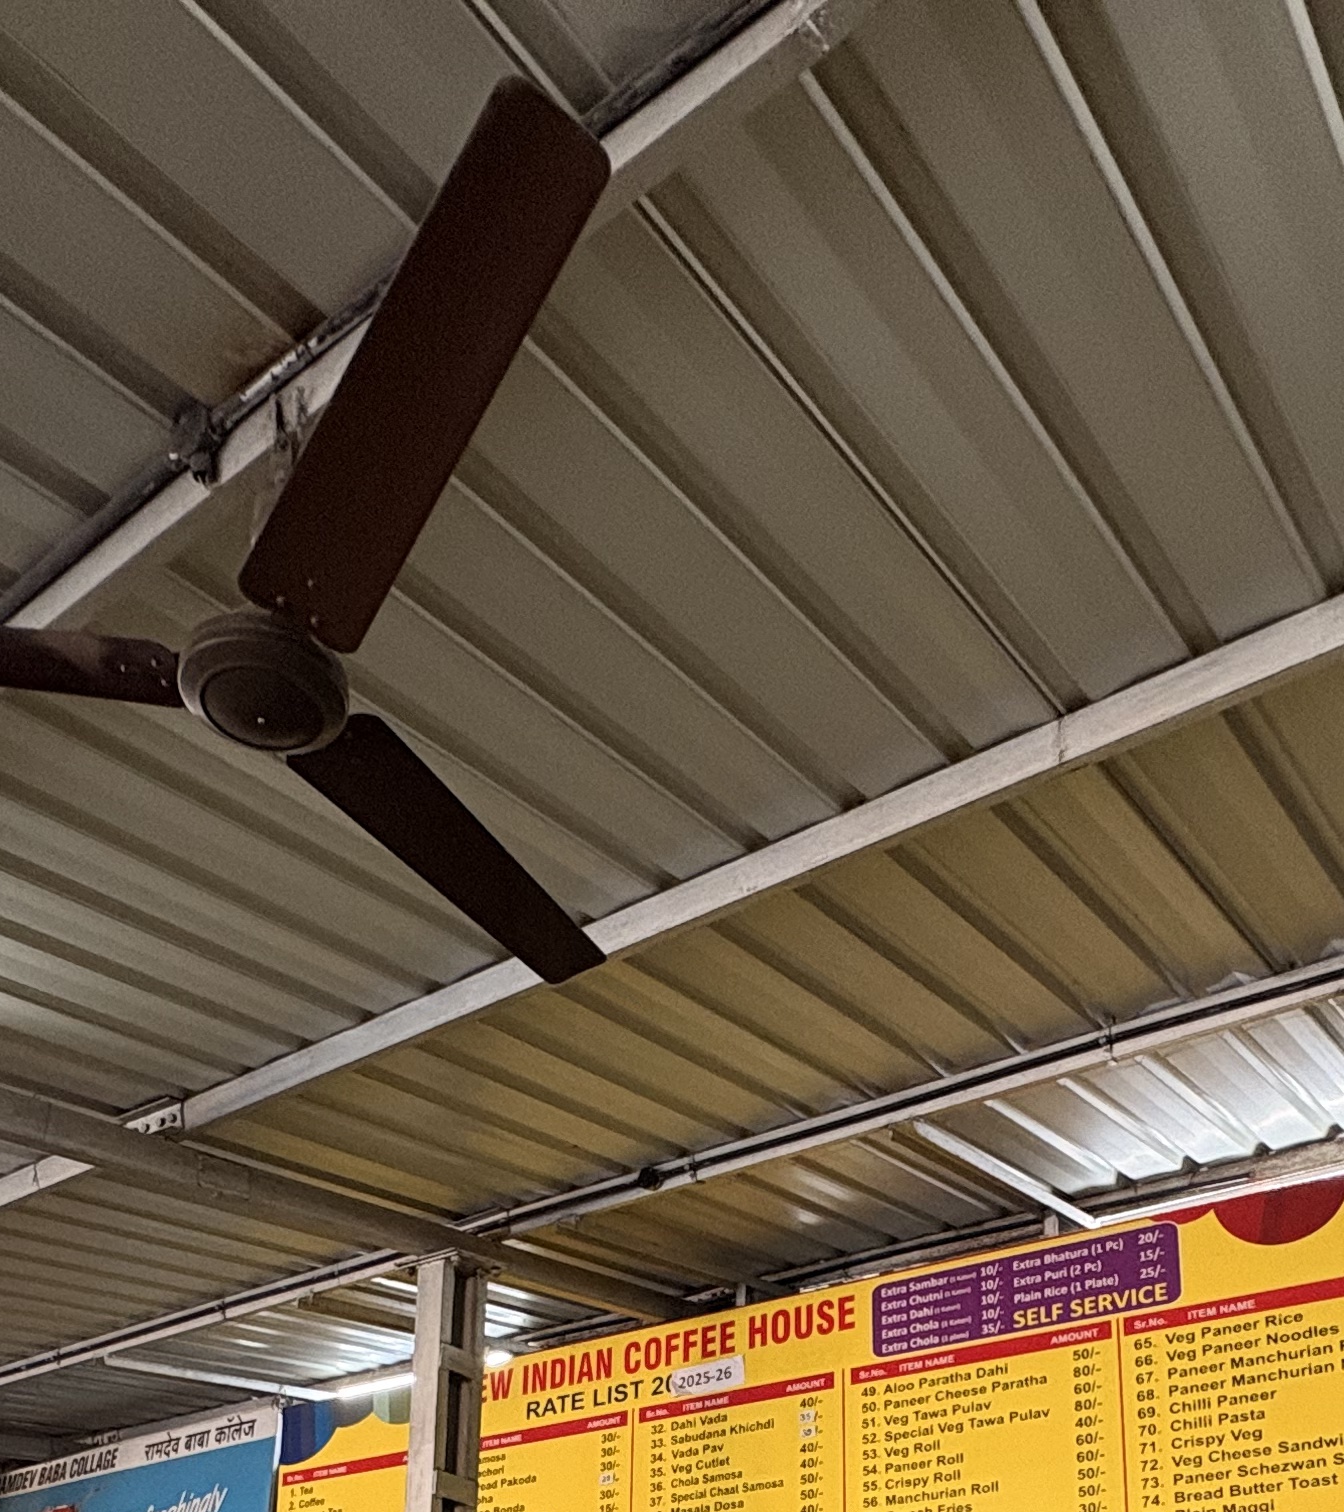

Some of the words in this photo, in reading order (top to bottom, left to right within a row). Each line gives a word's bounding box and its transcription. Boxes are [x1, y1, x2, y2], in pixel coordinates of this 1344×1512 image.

[1013, 1258, 1041, 1271] Extra
[1044, 1248, 1088, 1264] Bhatura
[1091, 1244, 1103, 1256] (1
[1106, 1238, 1123, 1251] Pc)
[1138, 1230, 1164, 1245] 20/-
[1014, 1275, 1042, 1287] Extra
[1044, 1267, 1067, 1281] Puri
[1070, 1265, 1081, 1278] (2
[1084, 1260, 1102, 1273] Pc)
[1140, 1247, 1165, 1262] 15/-
[1014, 1291, 1041, 1304] Plain
[1044, 1286, 1068, 1298] Rice
[1070, 1282, 1082, 1295] (1
[1085, 1274, 1119, 1290] Plate)
[1140, 1264, 1166, 1279] 25/-
[1013, 1303, 1064, 1327] SELF
[1070, 1283, 1168, 1318] SERVICE
[523, 1347, 613, 1395] INDIAN
[624, 1320, 736, 1374] COFFEE
[748, 1294, 856, 1349] HOUSE
[678, 1366, 732, 1389] 2025-26
[527, 1391, 585, 1420] RATE
[593, 1380, 644, 1407] LIST
[651, 1424, 666, 1435] 32.
[671, 1418, 696, 1431] Dahi
[700, 1413, 727, 1426] Vada
[800, 1396, 823, 1408] 40/-
[145, 1432, 180, 1461] रामदेव
[184, 1429, 211, 1452] बाबा
[215, 1415, 257, 1444] कॉलेज
[863, 1464, 881, 1476] 54.
[885, 1460, 933, 1474] Paneer
[936, 1453, 964, 1467] Roll
[1076, 1431, 1104, 1446] 60/-
[38, 1462, 67, 1486] BABA
[70, 1448, 119, 1479] COLLAGE
[1140, 1459, 1163, 1472] 72.
[1171, 1455, 1202, 1468] Veg
[1208, 1446, 1272, 1463] Cheese
[714, 1500, 744, 1512] Dosa
[800, 1488, 823, 1500] 50/-
[1078, 1483, 1107, 1497] 50/-
[1142, 1494, 1165, 1508] 74.
[1174, 1486, 1224, 1504] Bread
[1229, 1482, 1284, 1497] Butter
[1288, 1473, 1339, 1490] Toast
